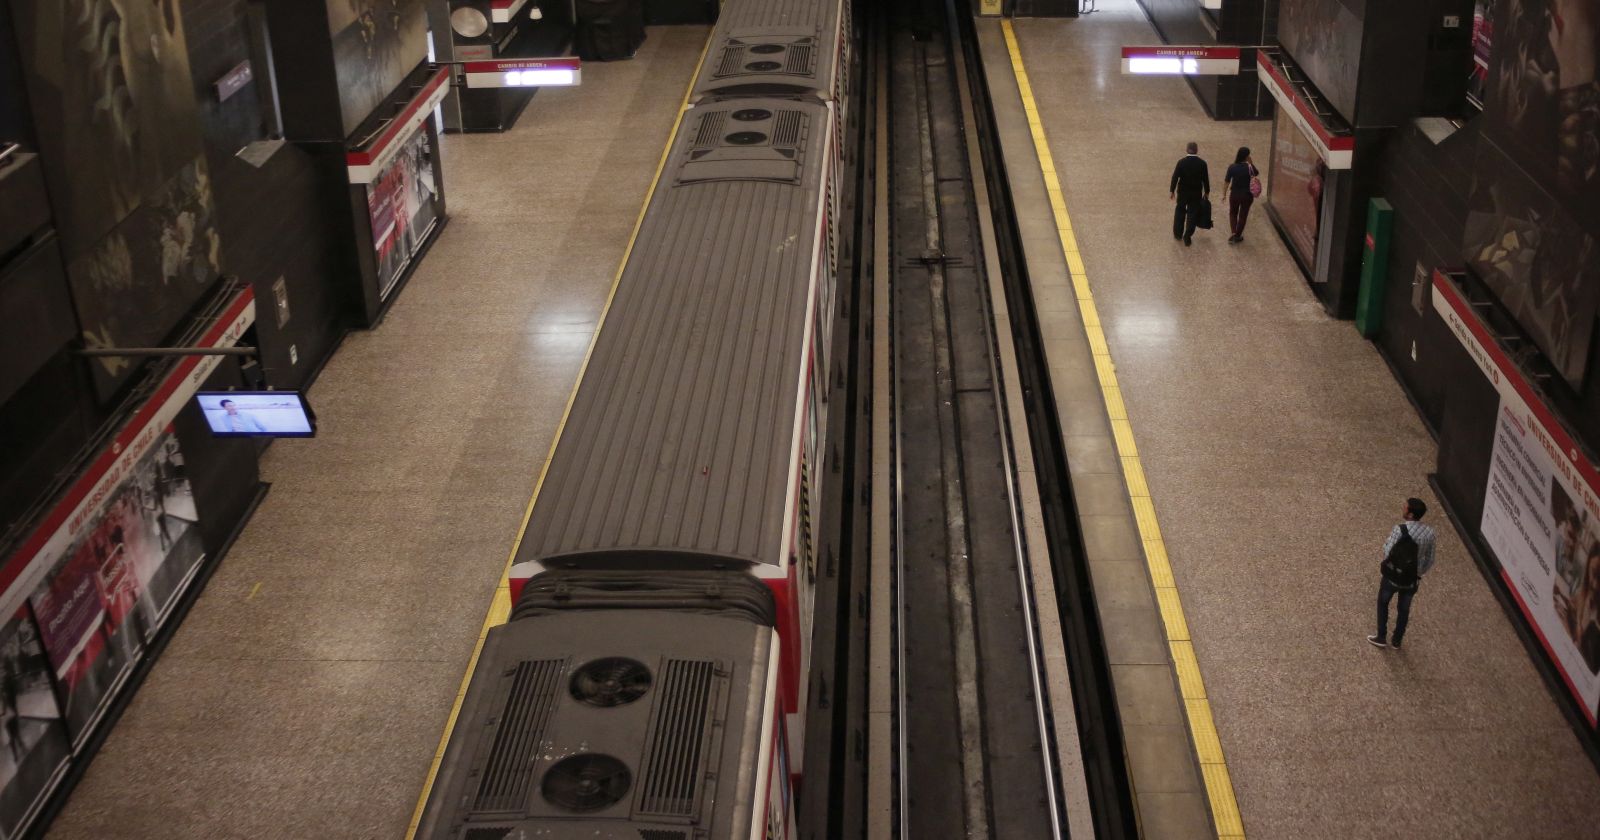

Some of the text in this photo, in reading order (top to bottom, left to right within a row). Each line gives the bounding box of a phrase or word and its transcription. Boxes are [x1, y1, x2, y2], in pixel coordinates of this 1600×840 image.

[1454, 318, 1467, 339] Salida
[1483, 358, 1493, 376] York
[68, 467, 121, 536] UNIVERSIDAD
[121, 452, 132, 473] DE
[133, 427, 153, 459] CHILE
[1527, 414, 1571, 480] UNIVERSIDAD
[1572, 474, 1582, 497] DE
[1530, 542, 1551, 577] EMPRESAS
